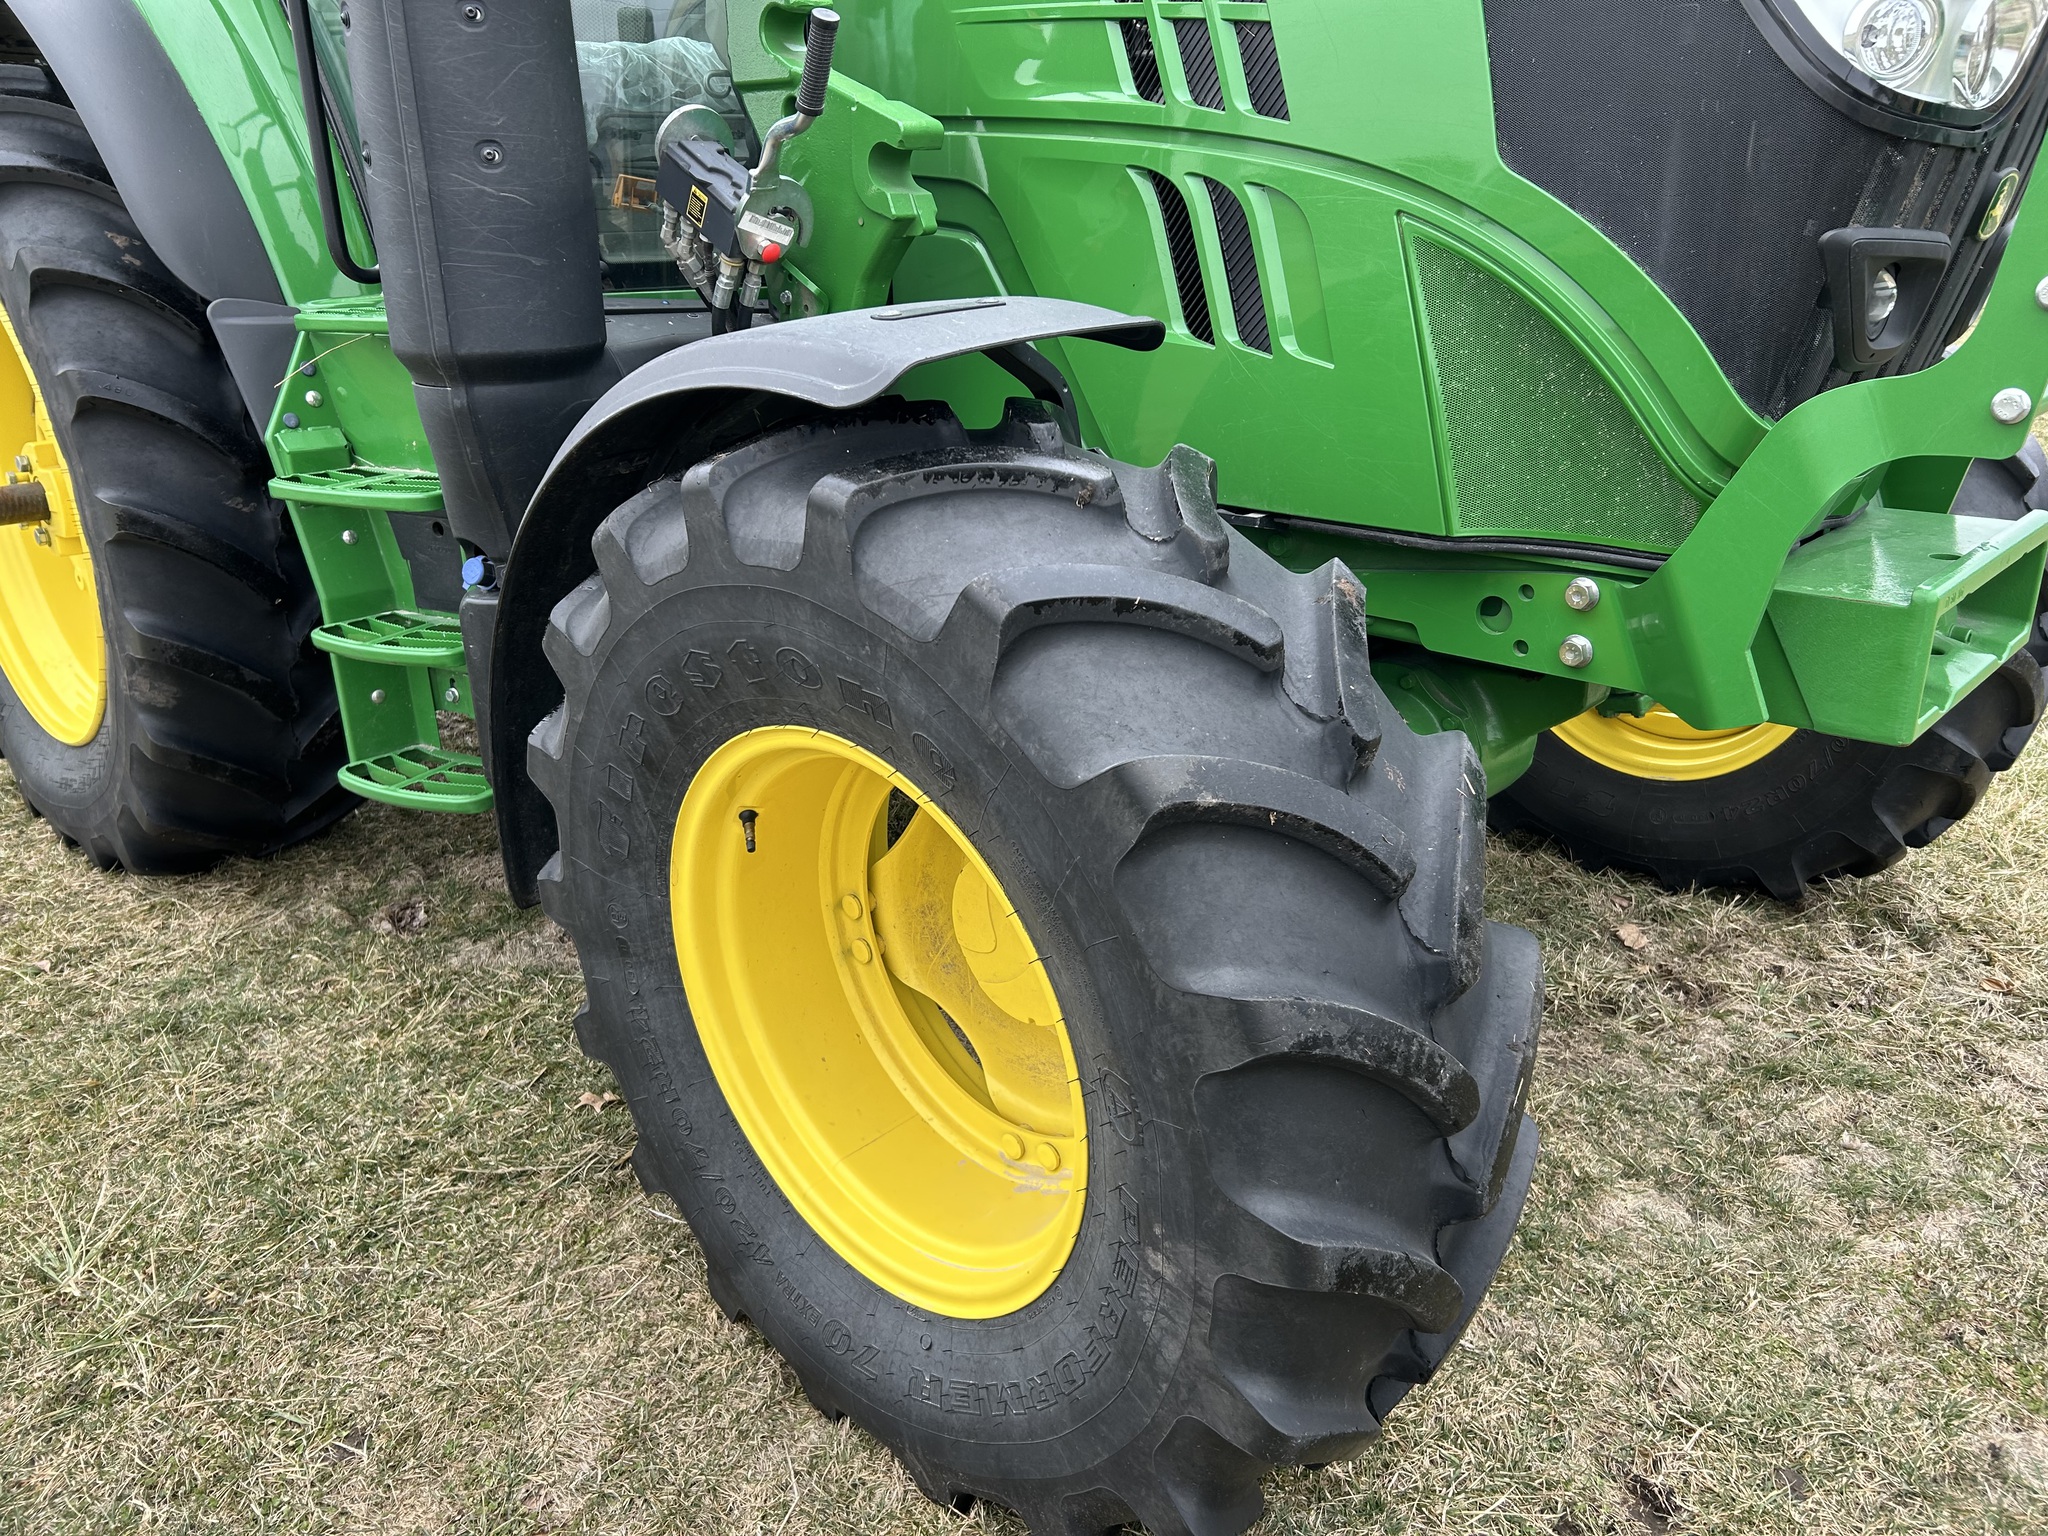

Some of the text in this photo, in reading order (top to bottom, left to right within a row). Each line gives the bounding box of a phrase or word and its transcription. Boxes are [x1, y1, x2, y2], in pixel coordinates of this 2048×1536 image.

[628, 1002, 775, 1267] 420/70R24
[776, 1269, 824, 1328] EXTRA
[822, 1317, 881, 1382] 70
[907, 1183, 1141, 1417] PERFORMER
